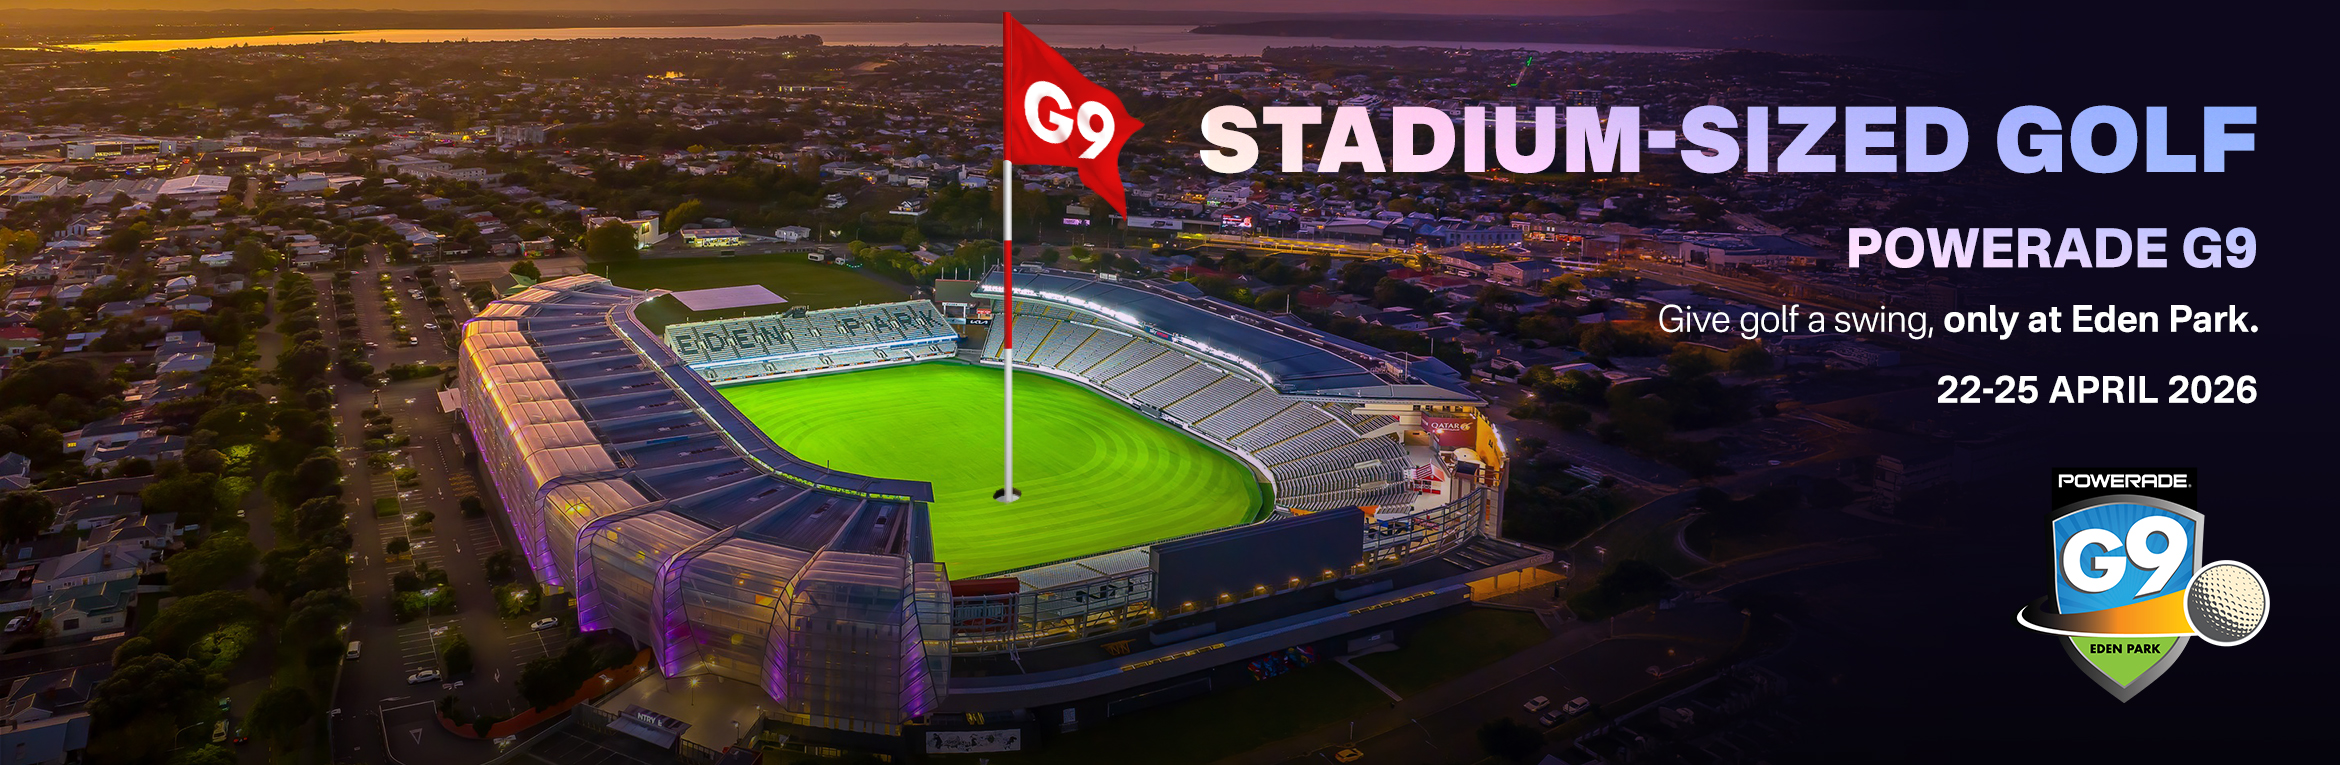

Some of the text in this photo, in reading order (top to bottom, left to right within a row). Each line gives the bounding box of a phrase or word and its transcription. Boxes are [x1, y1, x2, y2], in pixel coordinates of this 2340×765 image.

[675, 310, 942, 355] EDEN PARK
[1431, 421, 1460, 430] QATAR
